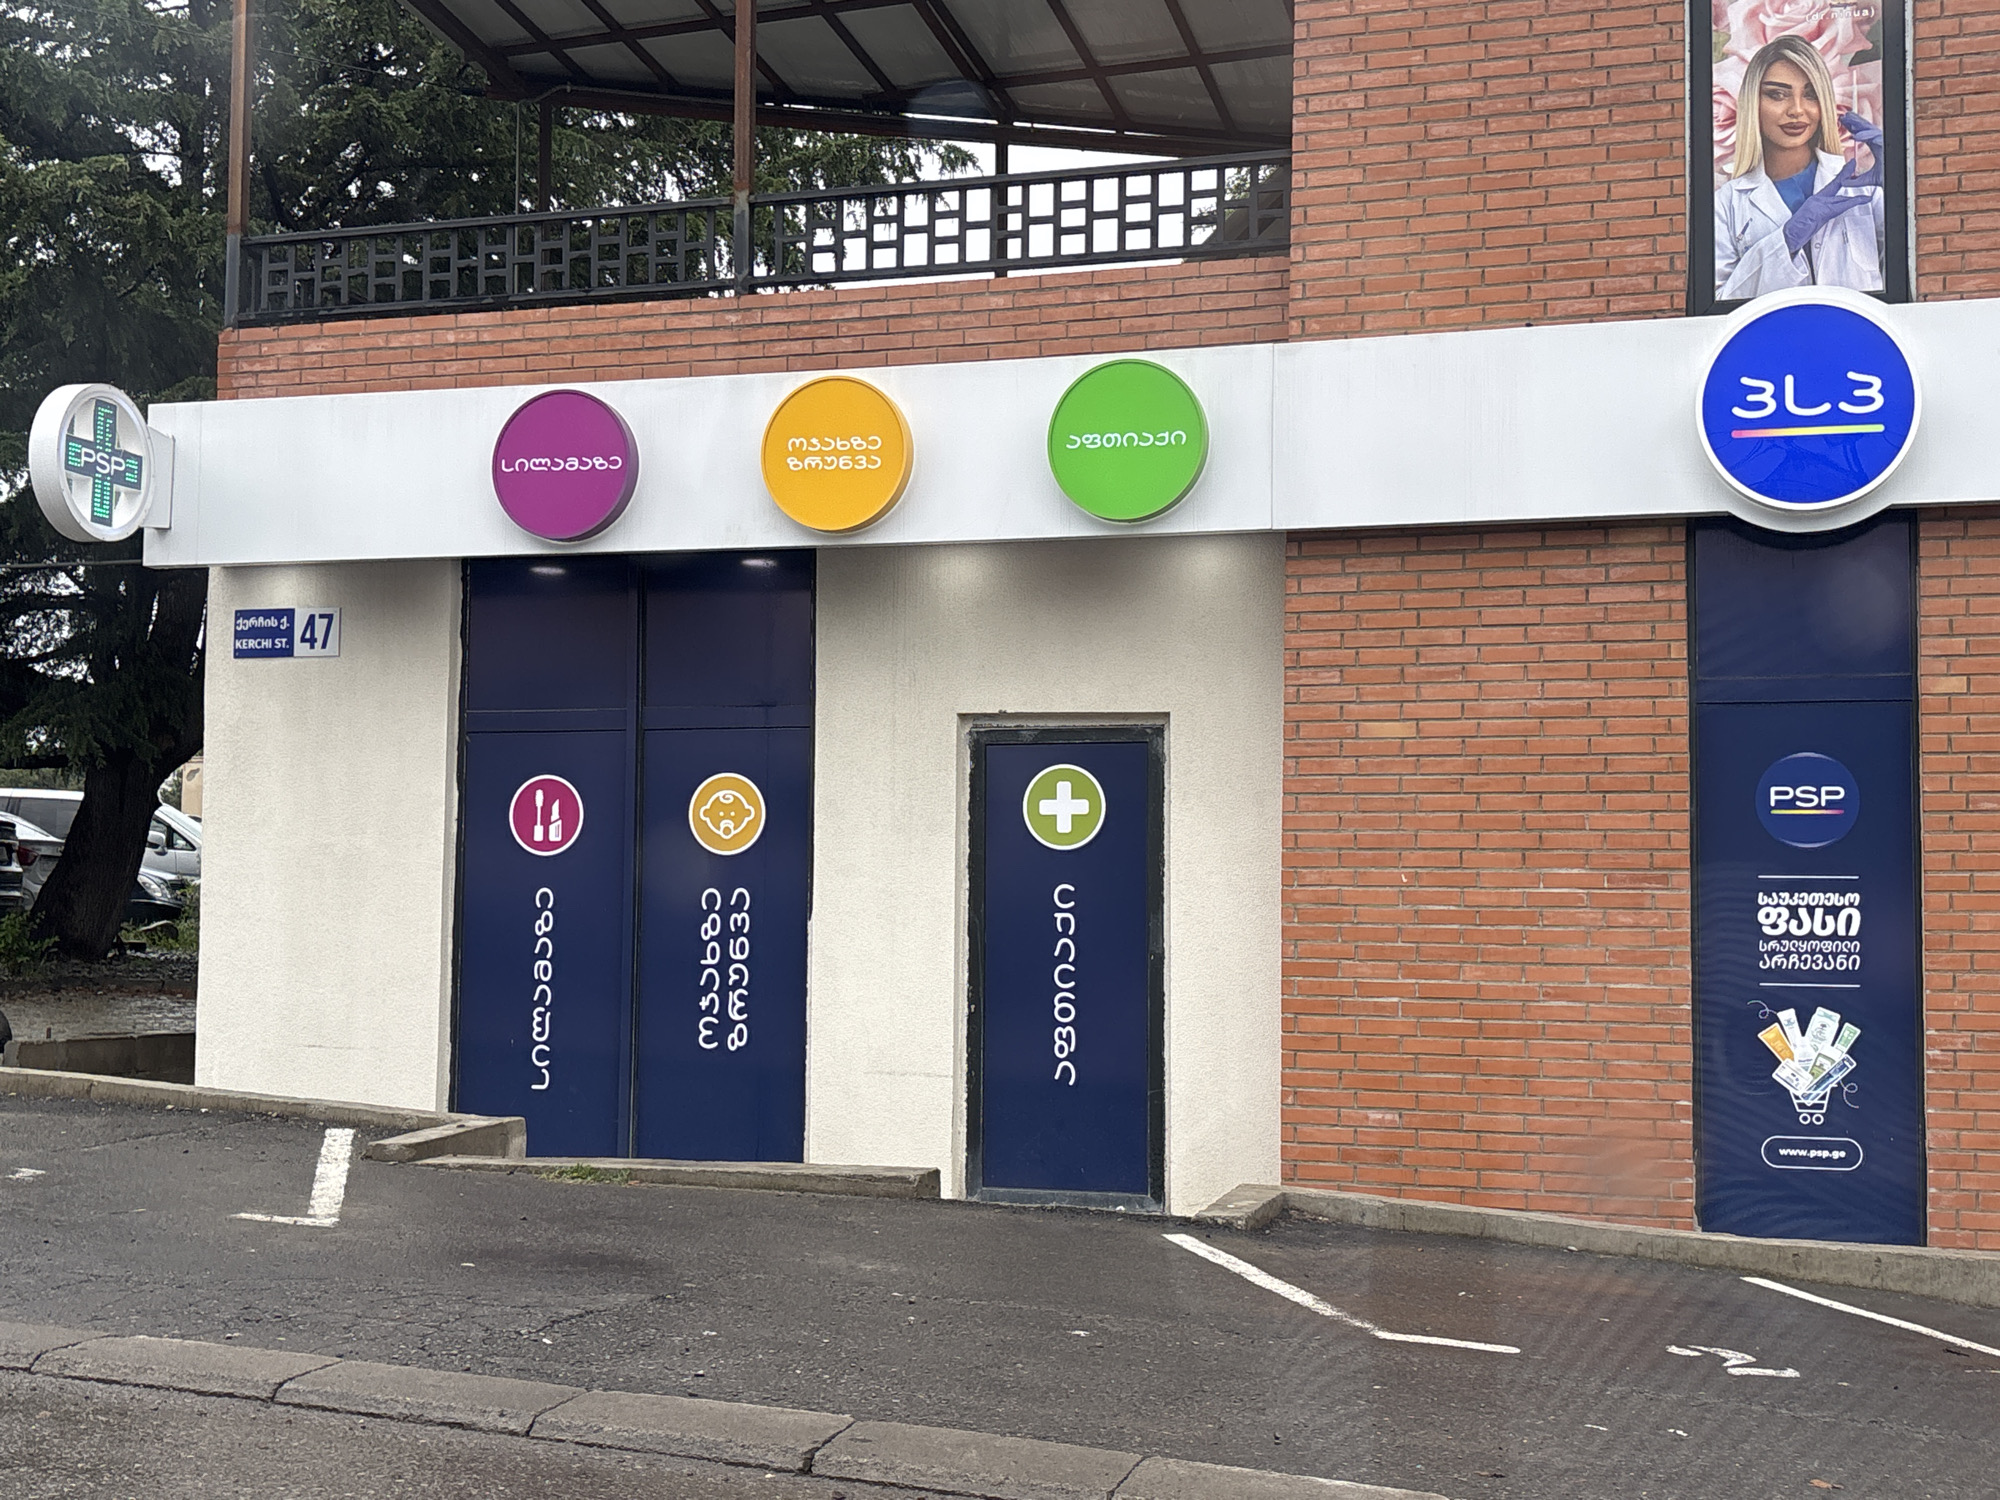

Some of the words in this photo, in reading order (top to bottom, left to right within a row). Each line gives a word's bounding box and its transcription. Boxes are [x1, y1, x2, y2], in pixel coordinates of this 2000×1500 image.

[787, 435, 882, 452] ოჯახზე
[1066, 430, 1187, 449] აფთიაქი
[81, 447, 126, 476] PSP
[501, 456, 622, 472] სილამაზე
[786, 455, 882, 471] ზრუნვა
[235, 616, 279, 631] ქერჩის
[280, 615, 290, 630] ქ.
[300, 613, 334, 650] 47
[235, 638, 272, 650] KERCHI
[274, 638, 290, 649] ST.
[1769, 786, 1845, 807] PSP
[1757, 892, 1860, 906] საუკეთესო
[1757, 906, 1861, 936] ფასი
[1759, 940, 1861, 953] სრულყოფილი
[698, 887, 721, 1049] ოჯახზე
[727, 887, 750, 1051] ზრუნვა
[1759, 953, 1861, 970] არჩევანი
[531, 887, 554, 1090] სილამაზე
[1053, 883, 1076, 1086] აფთიაქი
[1778, 1148, 1846, 1160] www.psp.ge
